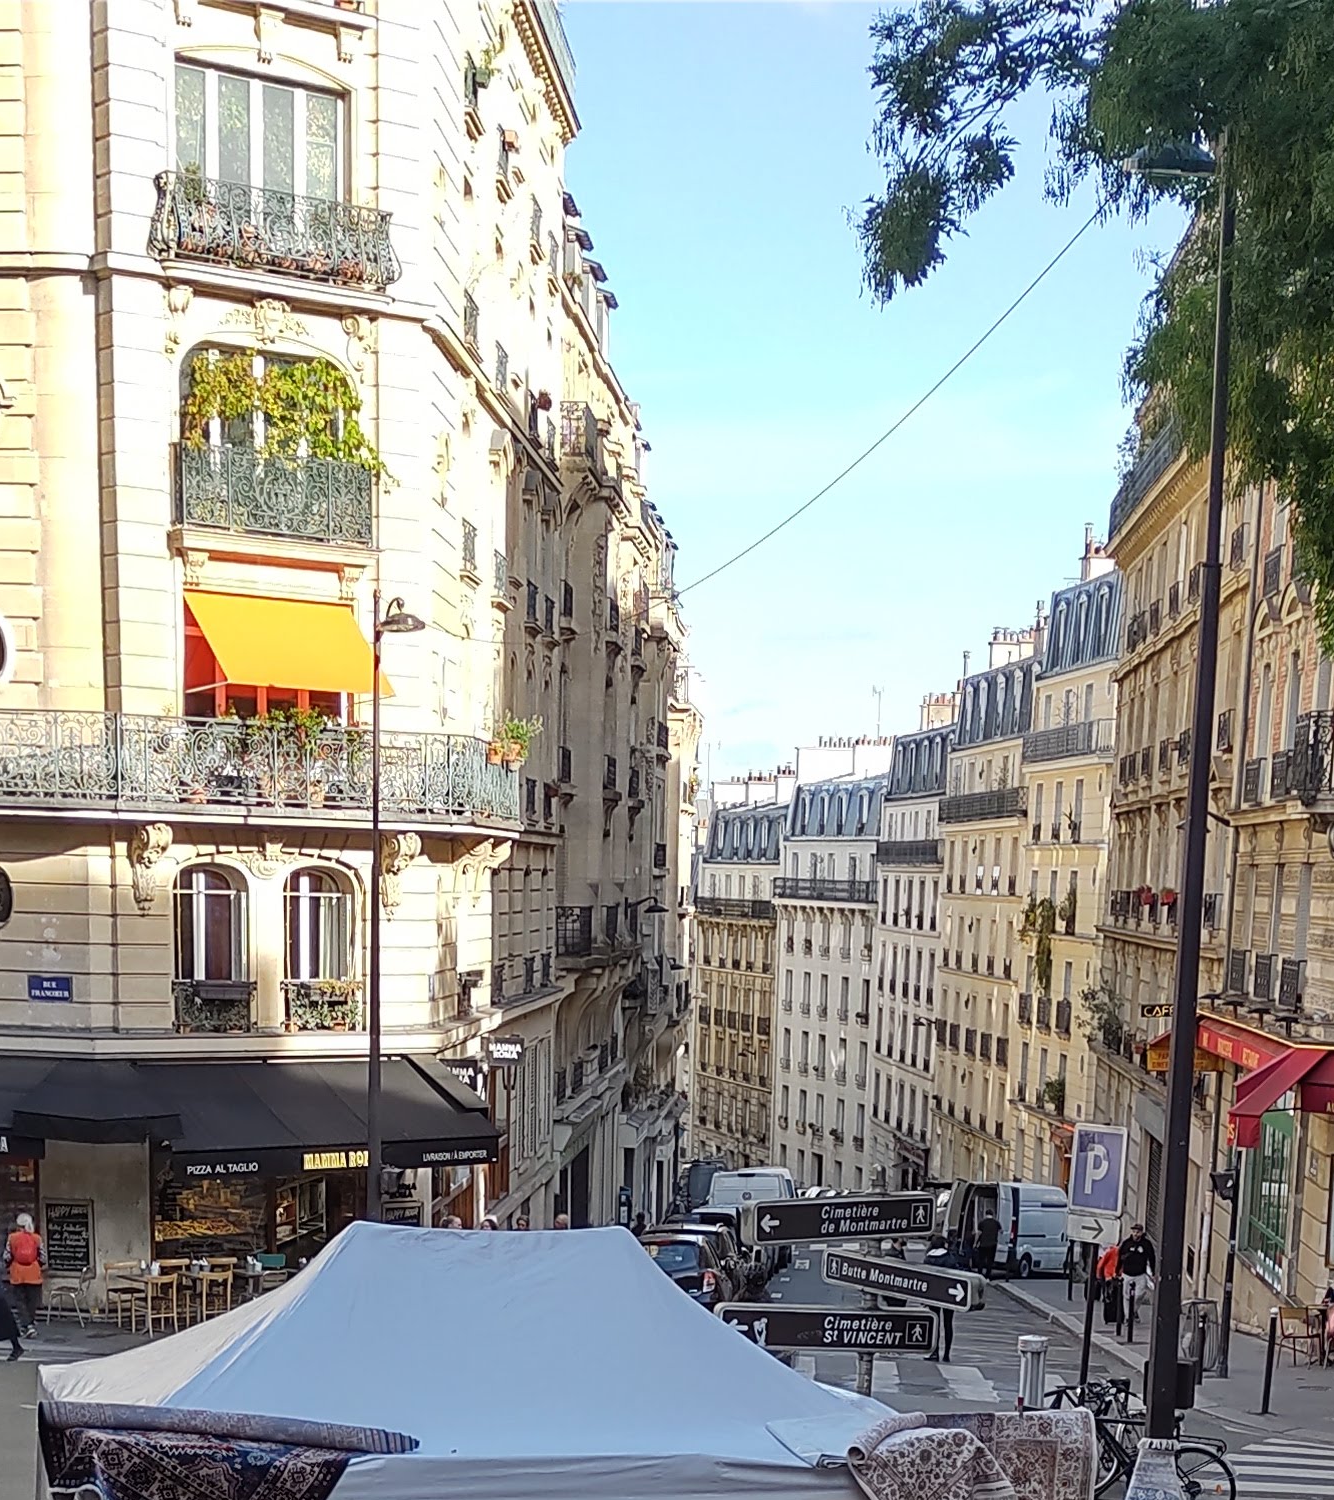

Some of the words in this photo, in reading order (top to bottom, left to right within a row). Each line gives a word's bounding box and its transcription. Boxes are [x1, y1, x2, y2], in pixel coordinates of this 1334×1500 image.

[488, 1043, 522, 1053] MAMMA
[493, 1051, 518, 1059] ROMA
[303, 1151, 347, 1170] MAMMA
[187, 1165, 212, 1175] PIZZA
[215, 1164, 226, 1174] AL
[228, 1162, 258, 1174] TAGLIO
[1084, 1144, 1108, 1194] P
[821, 1205, 879, 1219] Cimetière
[821, 1222, 835, 1234] de
[839, 1218, 908, 1233] Montmartre
[842, 1263, 866, 1280] Butte
[870, 1269, 928, 1292] Montmartre
[823, 1316, 893, 1331] Cimetière
[823, 1330, 839, 1343] St
[843, 1332, 903, 1345] VINCENT
